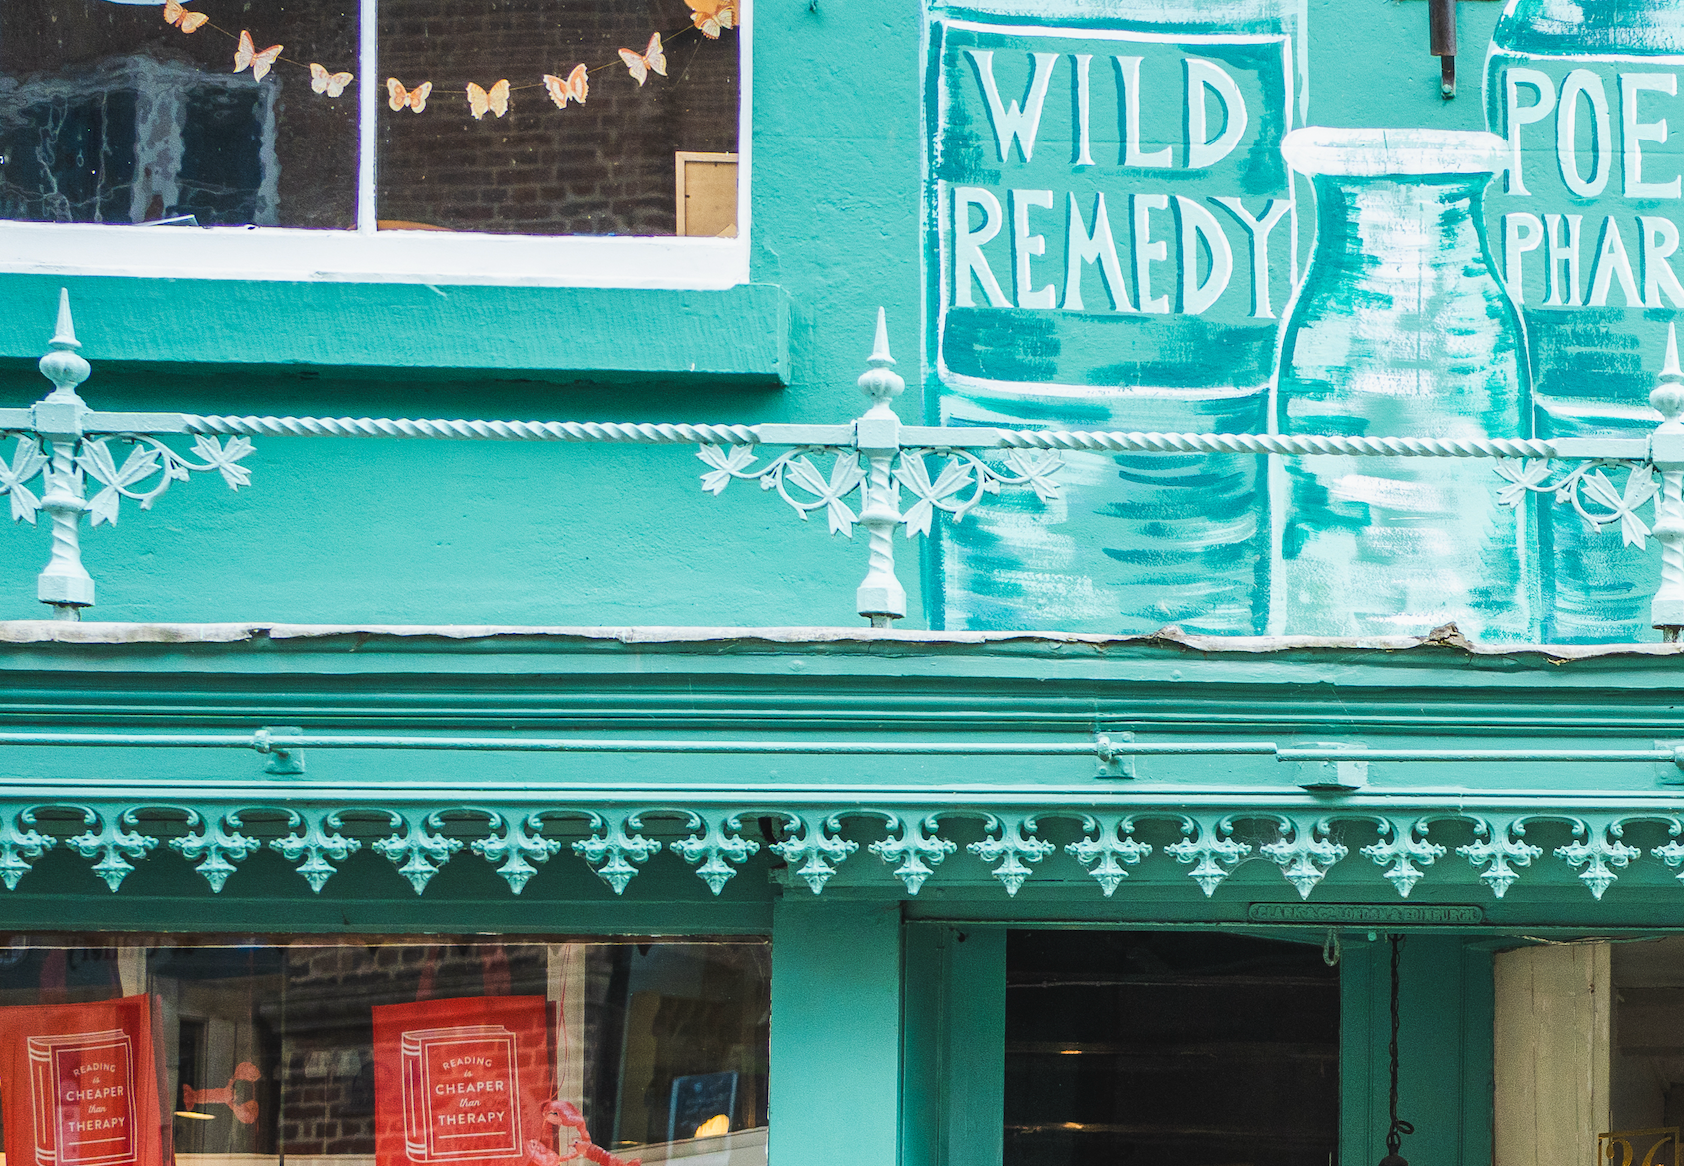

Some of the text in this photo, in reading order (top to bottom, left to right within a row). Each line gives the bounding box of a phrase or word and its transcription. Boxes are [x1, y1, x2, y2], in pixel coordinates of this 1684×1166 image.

[962, 50, 1248, 169] WILD
[951, 187, 1292, 319] REMEDY
[73, 1062, 116, 1077] READING
[443, 1056, 493, 1069] READING
[92, 1076, 100, 1085] is
[464, 1069, 472, 1078] is
[66, 1086, 124, 1102] CHEAPER
[436, 1080, 504, 1094] CHEAPER
[88, 1103, 107, 1114] than
[460, 1097, 481, 1109] than
[68, 1116, 126, 1132] THERAPY
[438, 1111, 505, 1126] THERAPY
